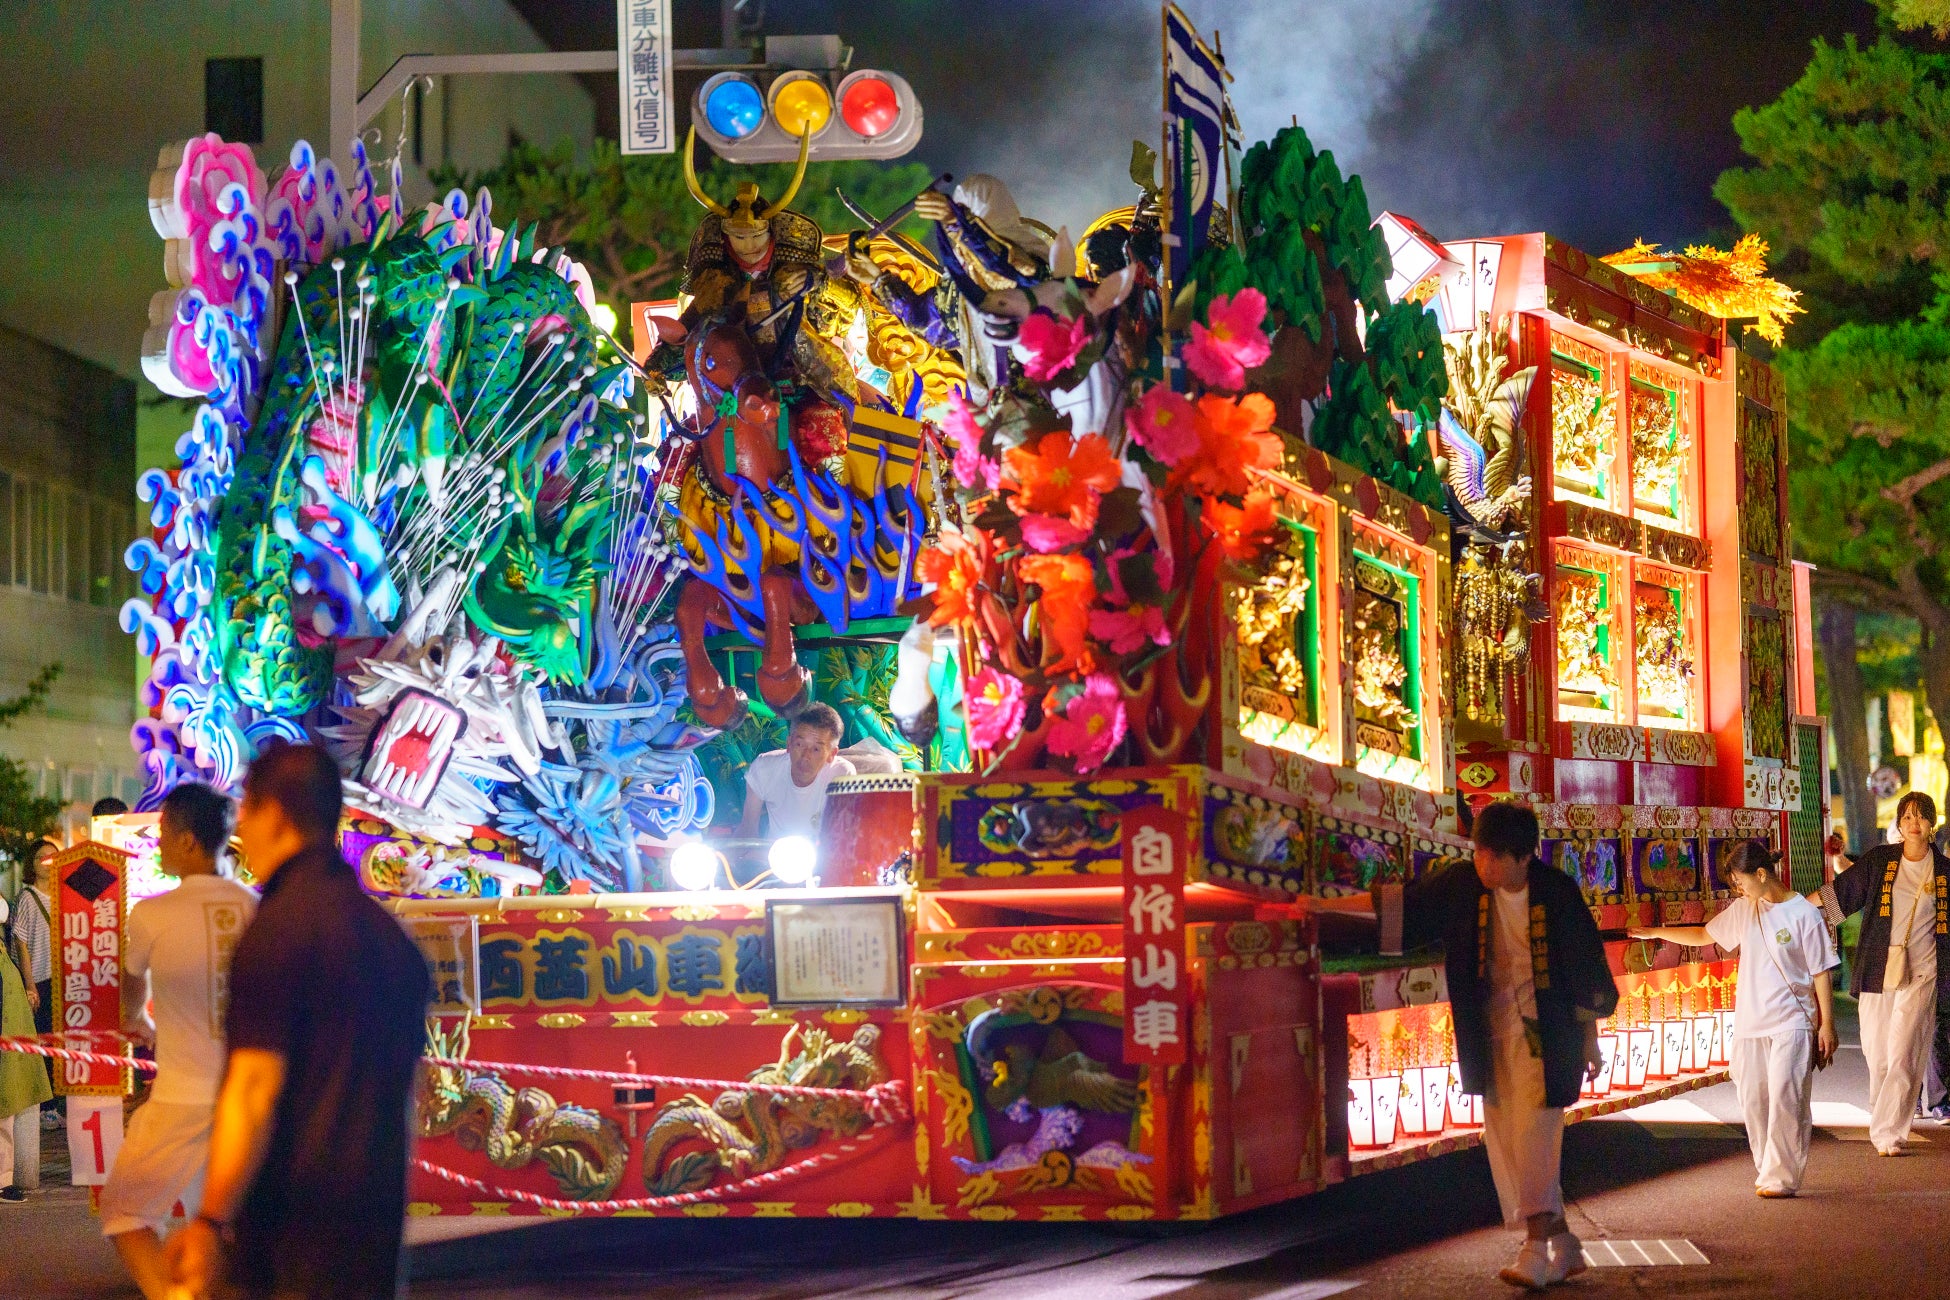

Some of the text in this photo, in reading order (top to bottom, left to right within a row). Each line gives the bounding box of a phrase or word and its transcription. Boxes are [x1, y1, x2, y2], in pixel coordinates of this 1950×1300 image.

[92, 899, 119, 987] 第四次
[81, 1110, 106, 1175] 1
